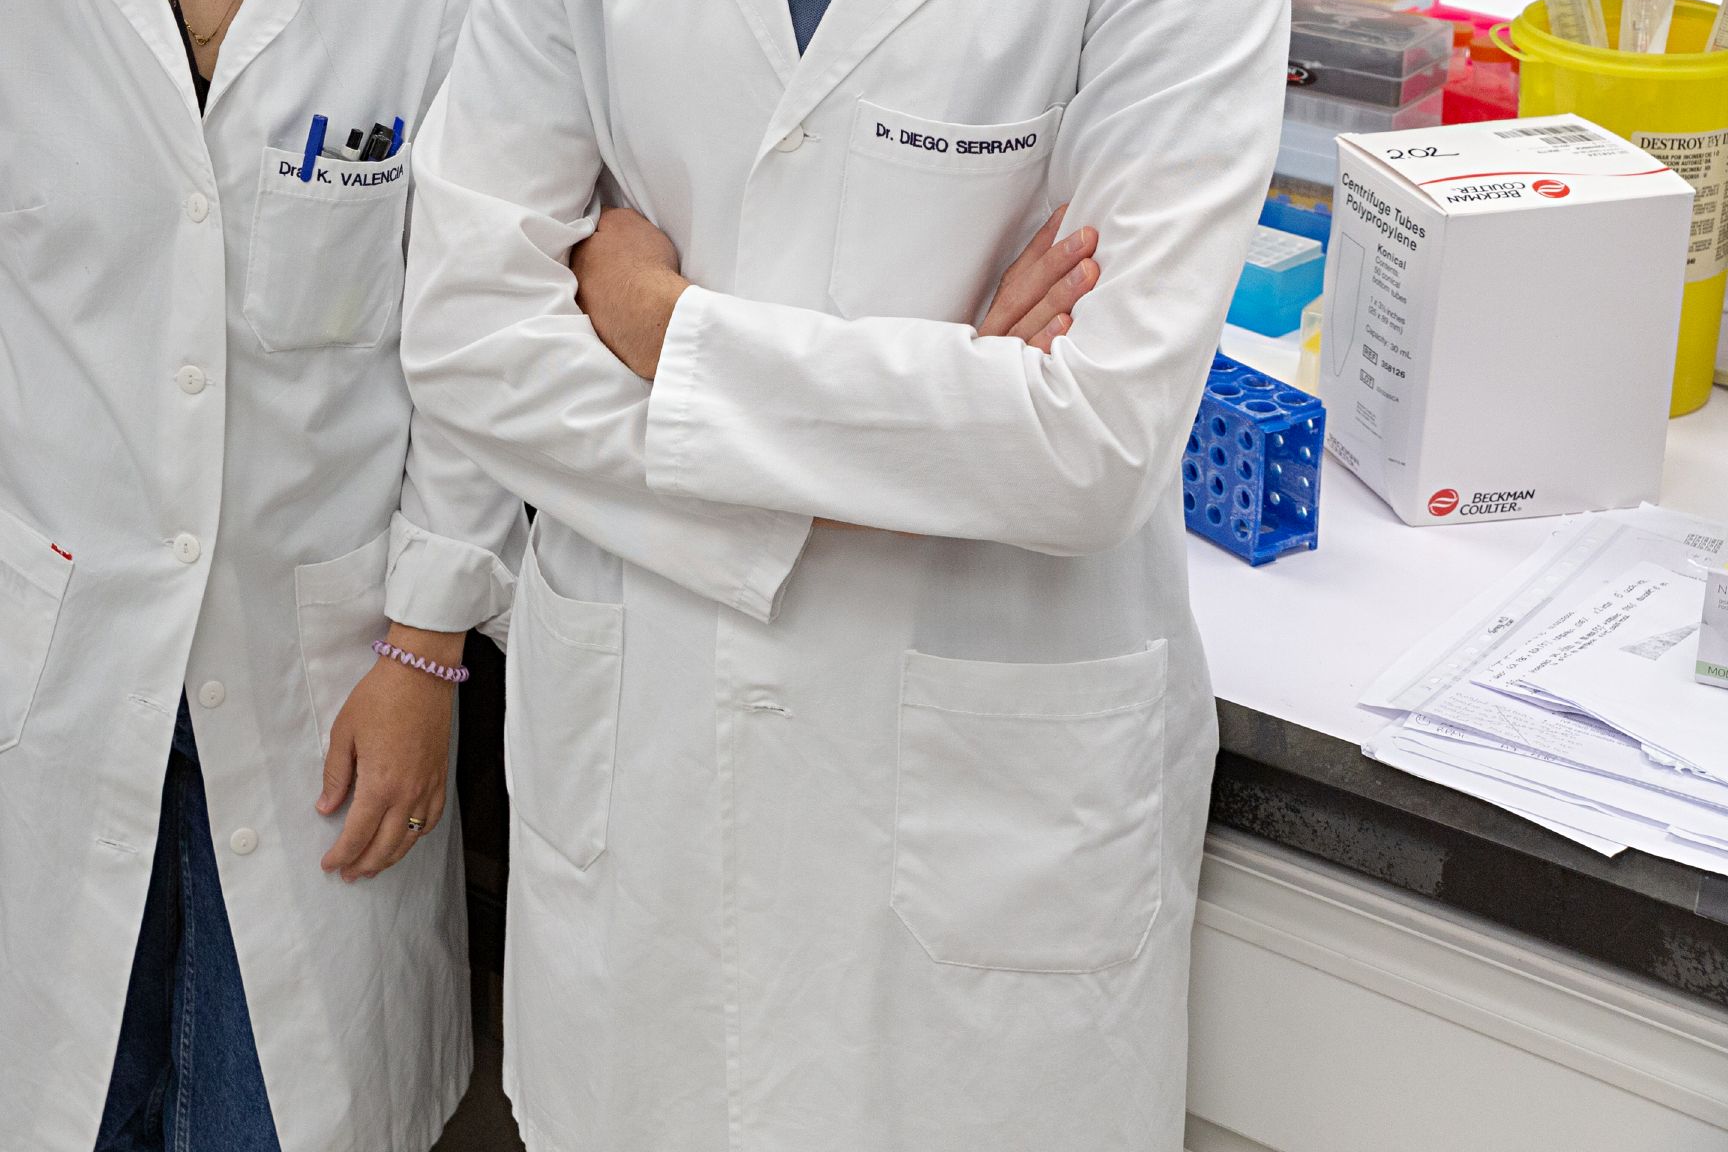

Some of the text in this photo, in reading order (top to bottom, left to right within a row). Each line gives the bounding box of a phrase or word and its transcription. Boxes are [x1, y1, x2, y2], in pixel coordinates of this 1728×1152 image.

[875, 122, 1037, 154] Dr. DIEGO SERRANO
[1640, 136, 1704, 150] DESTROY
[317, 168, 332, 184] K.
[1458, 181, 1526, 193] COULTER
[1446, 189, 1522, 204] BECKMAN
[1341, 172, 1426, 238] Centrifuge Tubes
[1346, 193, 1418, 251] Polypropylene
[1377, 243, 1407, 270] Konical
[1472, 488, 1536, 504] BECKMAN
[1459, 502, 1518, 516] COULTER
